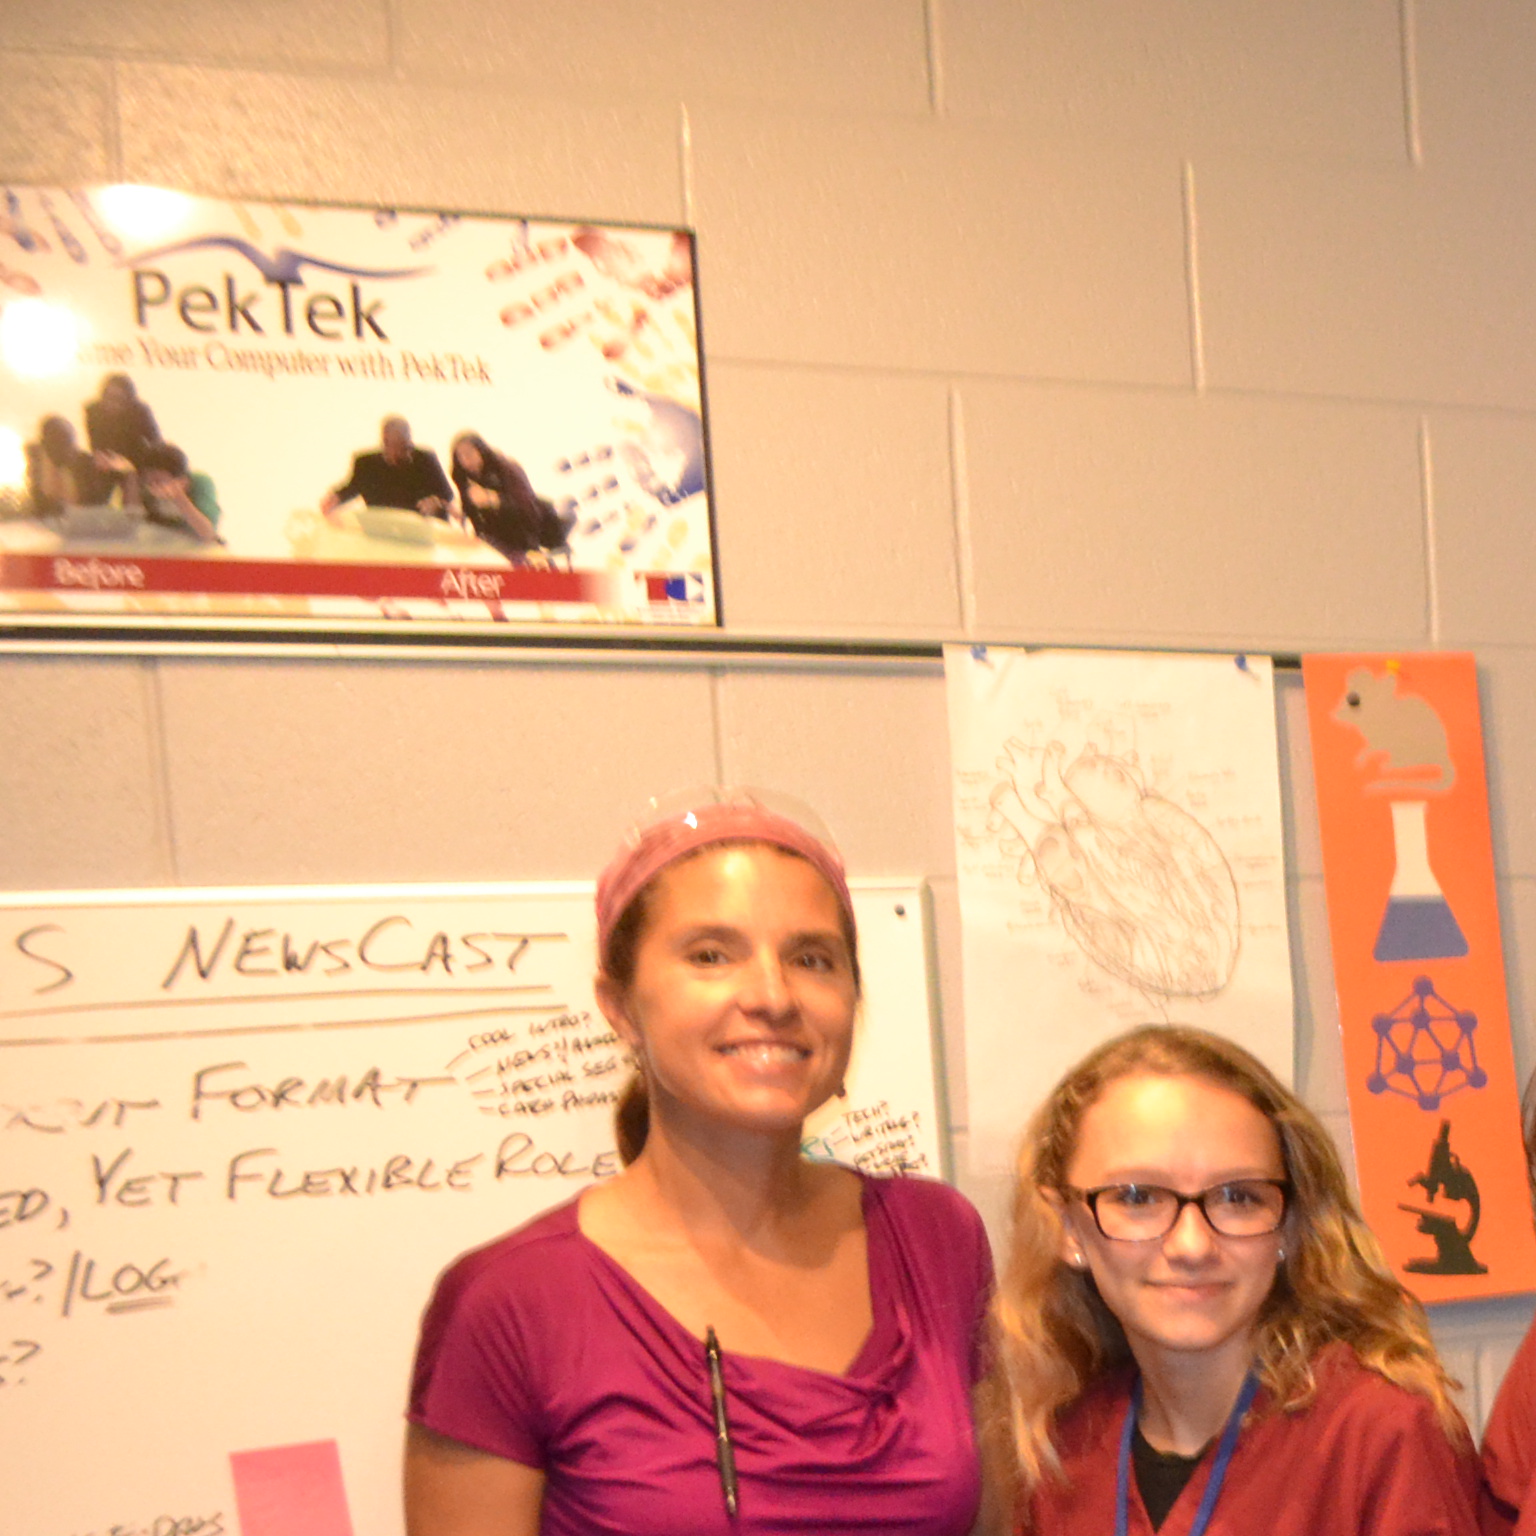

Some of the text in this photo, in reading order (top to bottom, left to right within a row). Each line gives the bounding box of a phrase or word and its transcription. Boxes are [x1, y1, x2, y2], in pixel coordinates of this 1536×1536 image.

[132, 267, 390, 343] PekTek
[136, 335, 199, 370] Your
[205, 337, 331, 380] Computer
[338, 349, 396, 379] with
[401, 349, 493, 386] PekTek
[54, 557, 505, 600] Before After
[191, 1060, 458, 1121] FORMAT
[91, 1146, 206, 1206] YET
[226, 1147, 486, 1200] FLEXIBLE
